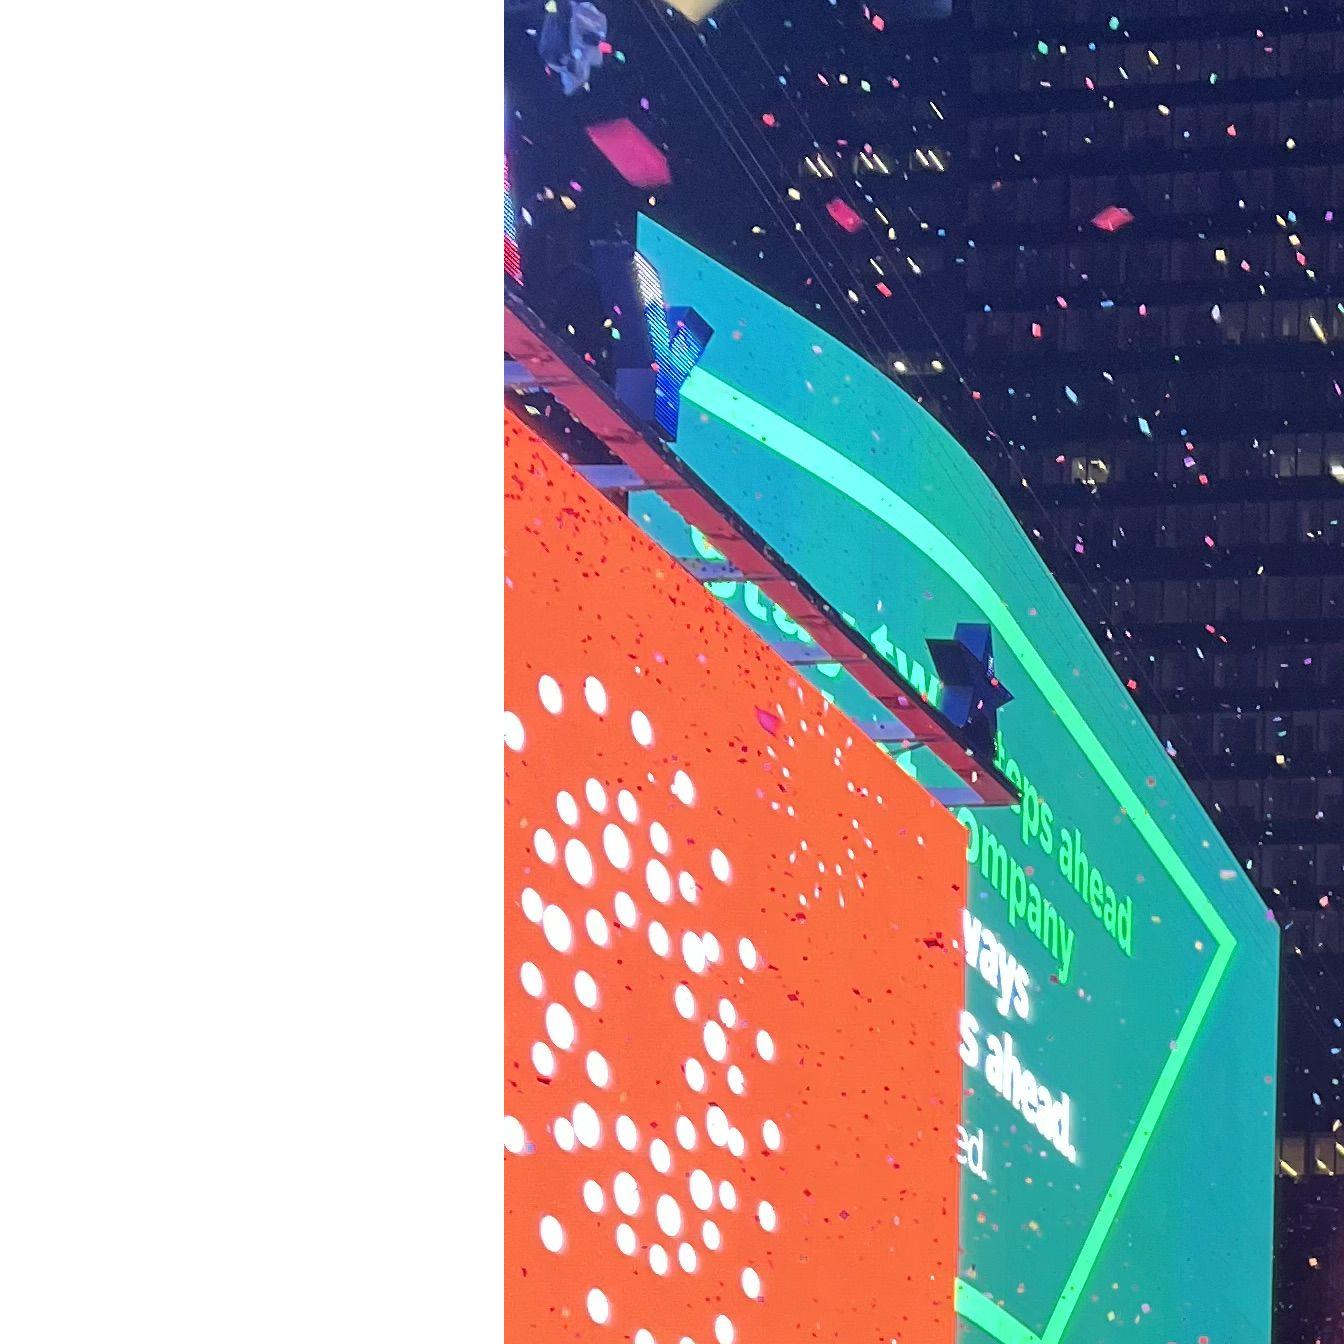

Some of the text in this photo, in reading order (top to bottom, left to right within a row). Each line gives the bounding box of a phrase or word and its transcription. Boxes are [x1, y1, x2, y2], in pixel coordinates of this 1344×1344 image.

[957, 807, 1075, 984] ompany
[1059, 828, 1133, 958] ahead
[984, 1031, 1077, 1164] ahead.
